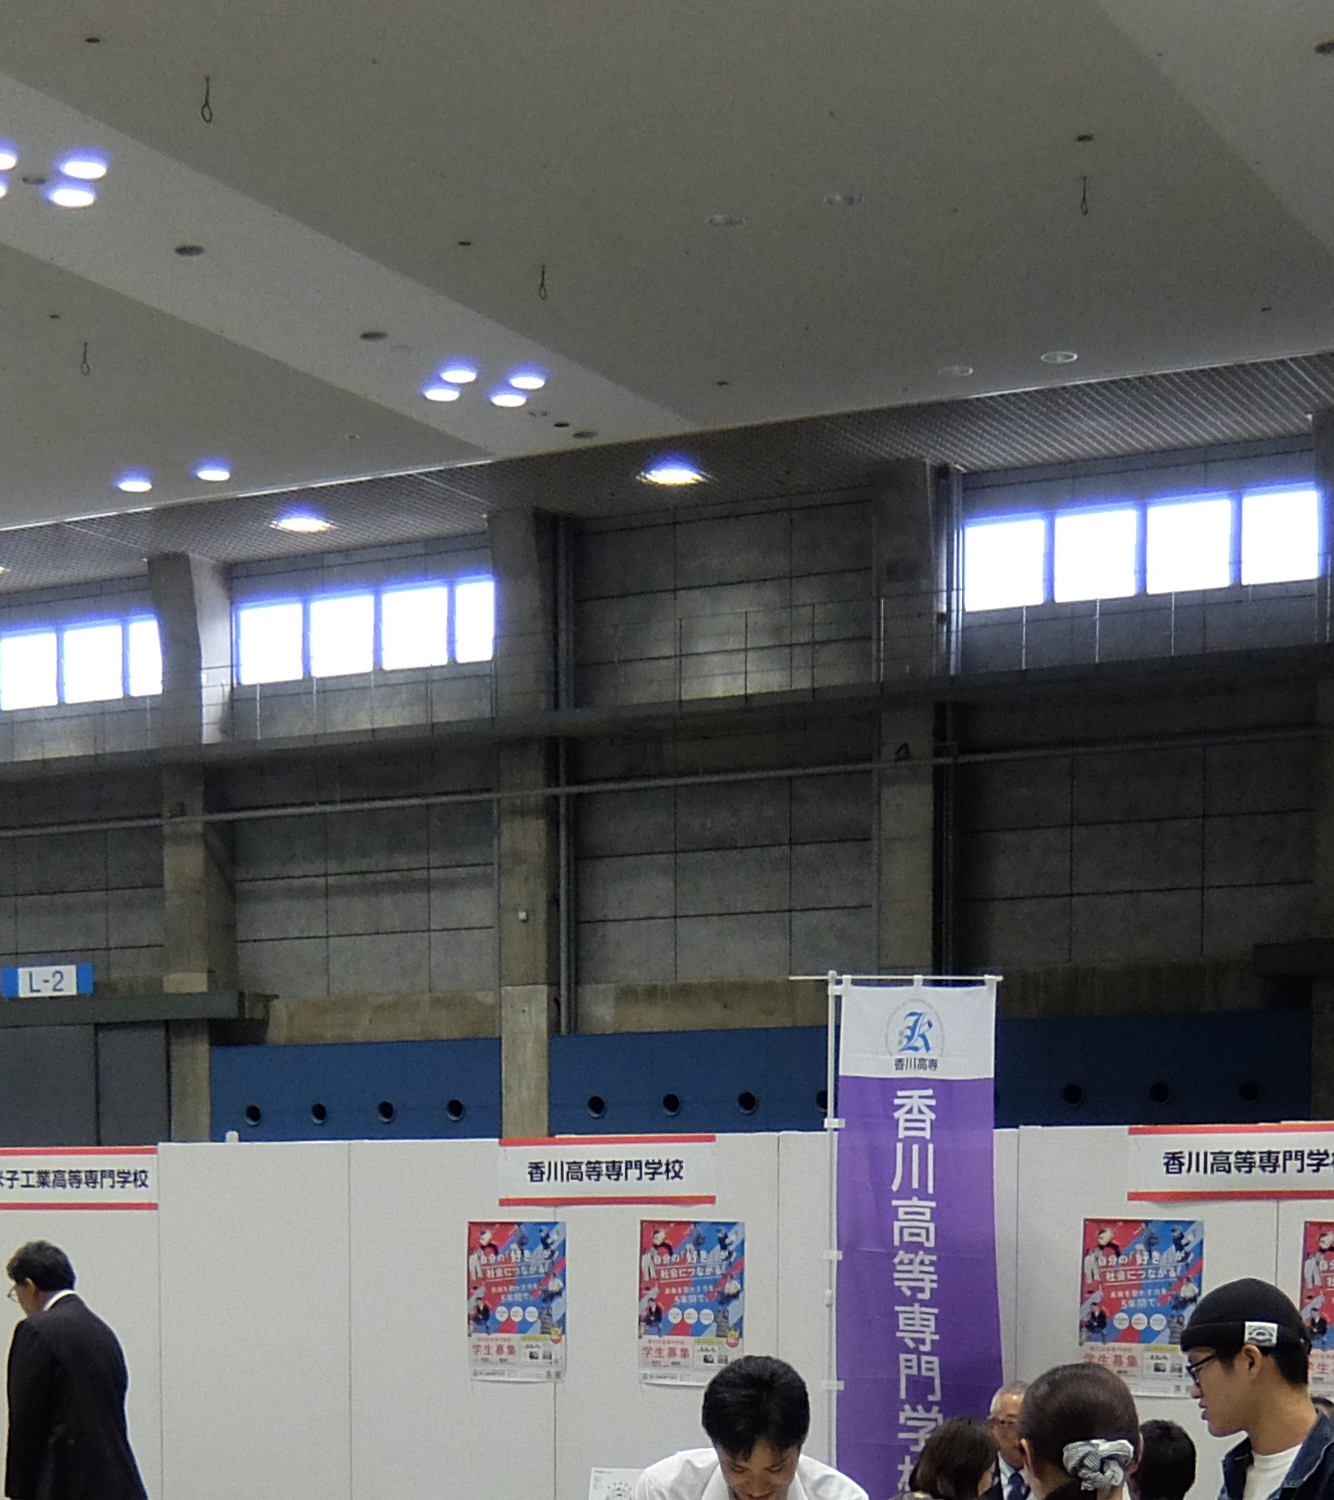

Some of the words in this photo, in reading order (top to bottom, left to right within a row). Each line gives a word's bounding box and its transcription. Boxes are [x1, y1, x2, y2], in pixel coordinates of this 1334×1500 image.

[28, 971, 66, 994] L-2
[894, 1057, 938, 1071] 香川高専
[527, 1159, 684, 1182] 香川高等専門学校
